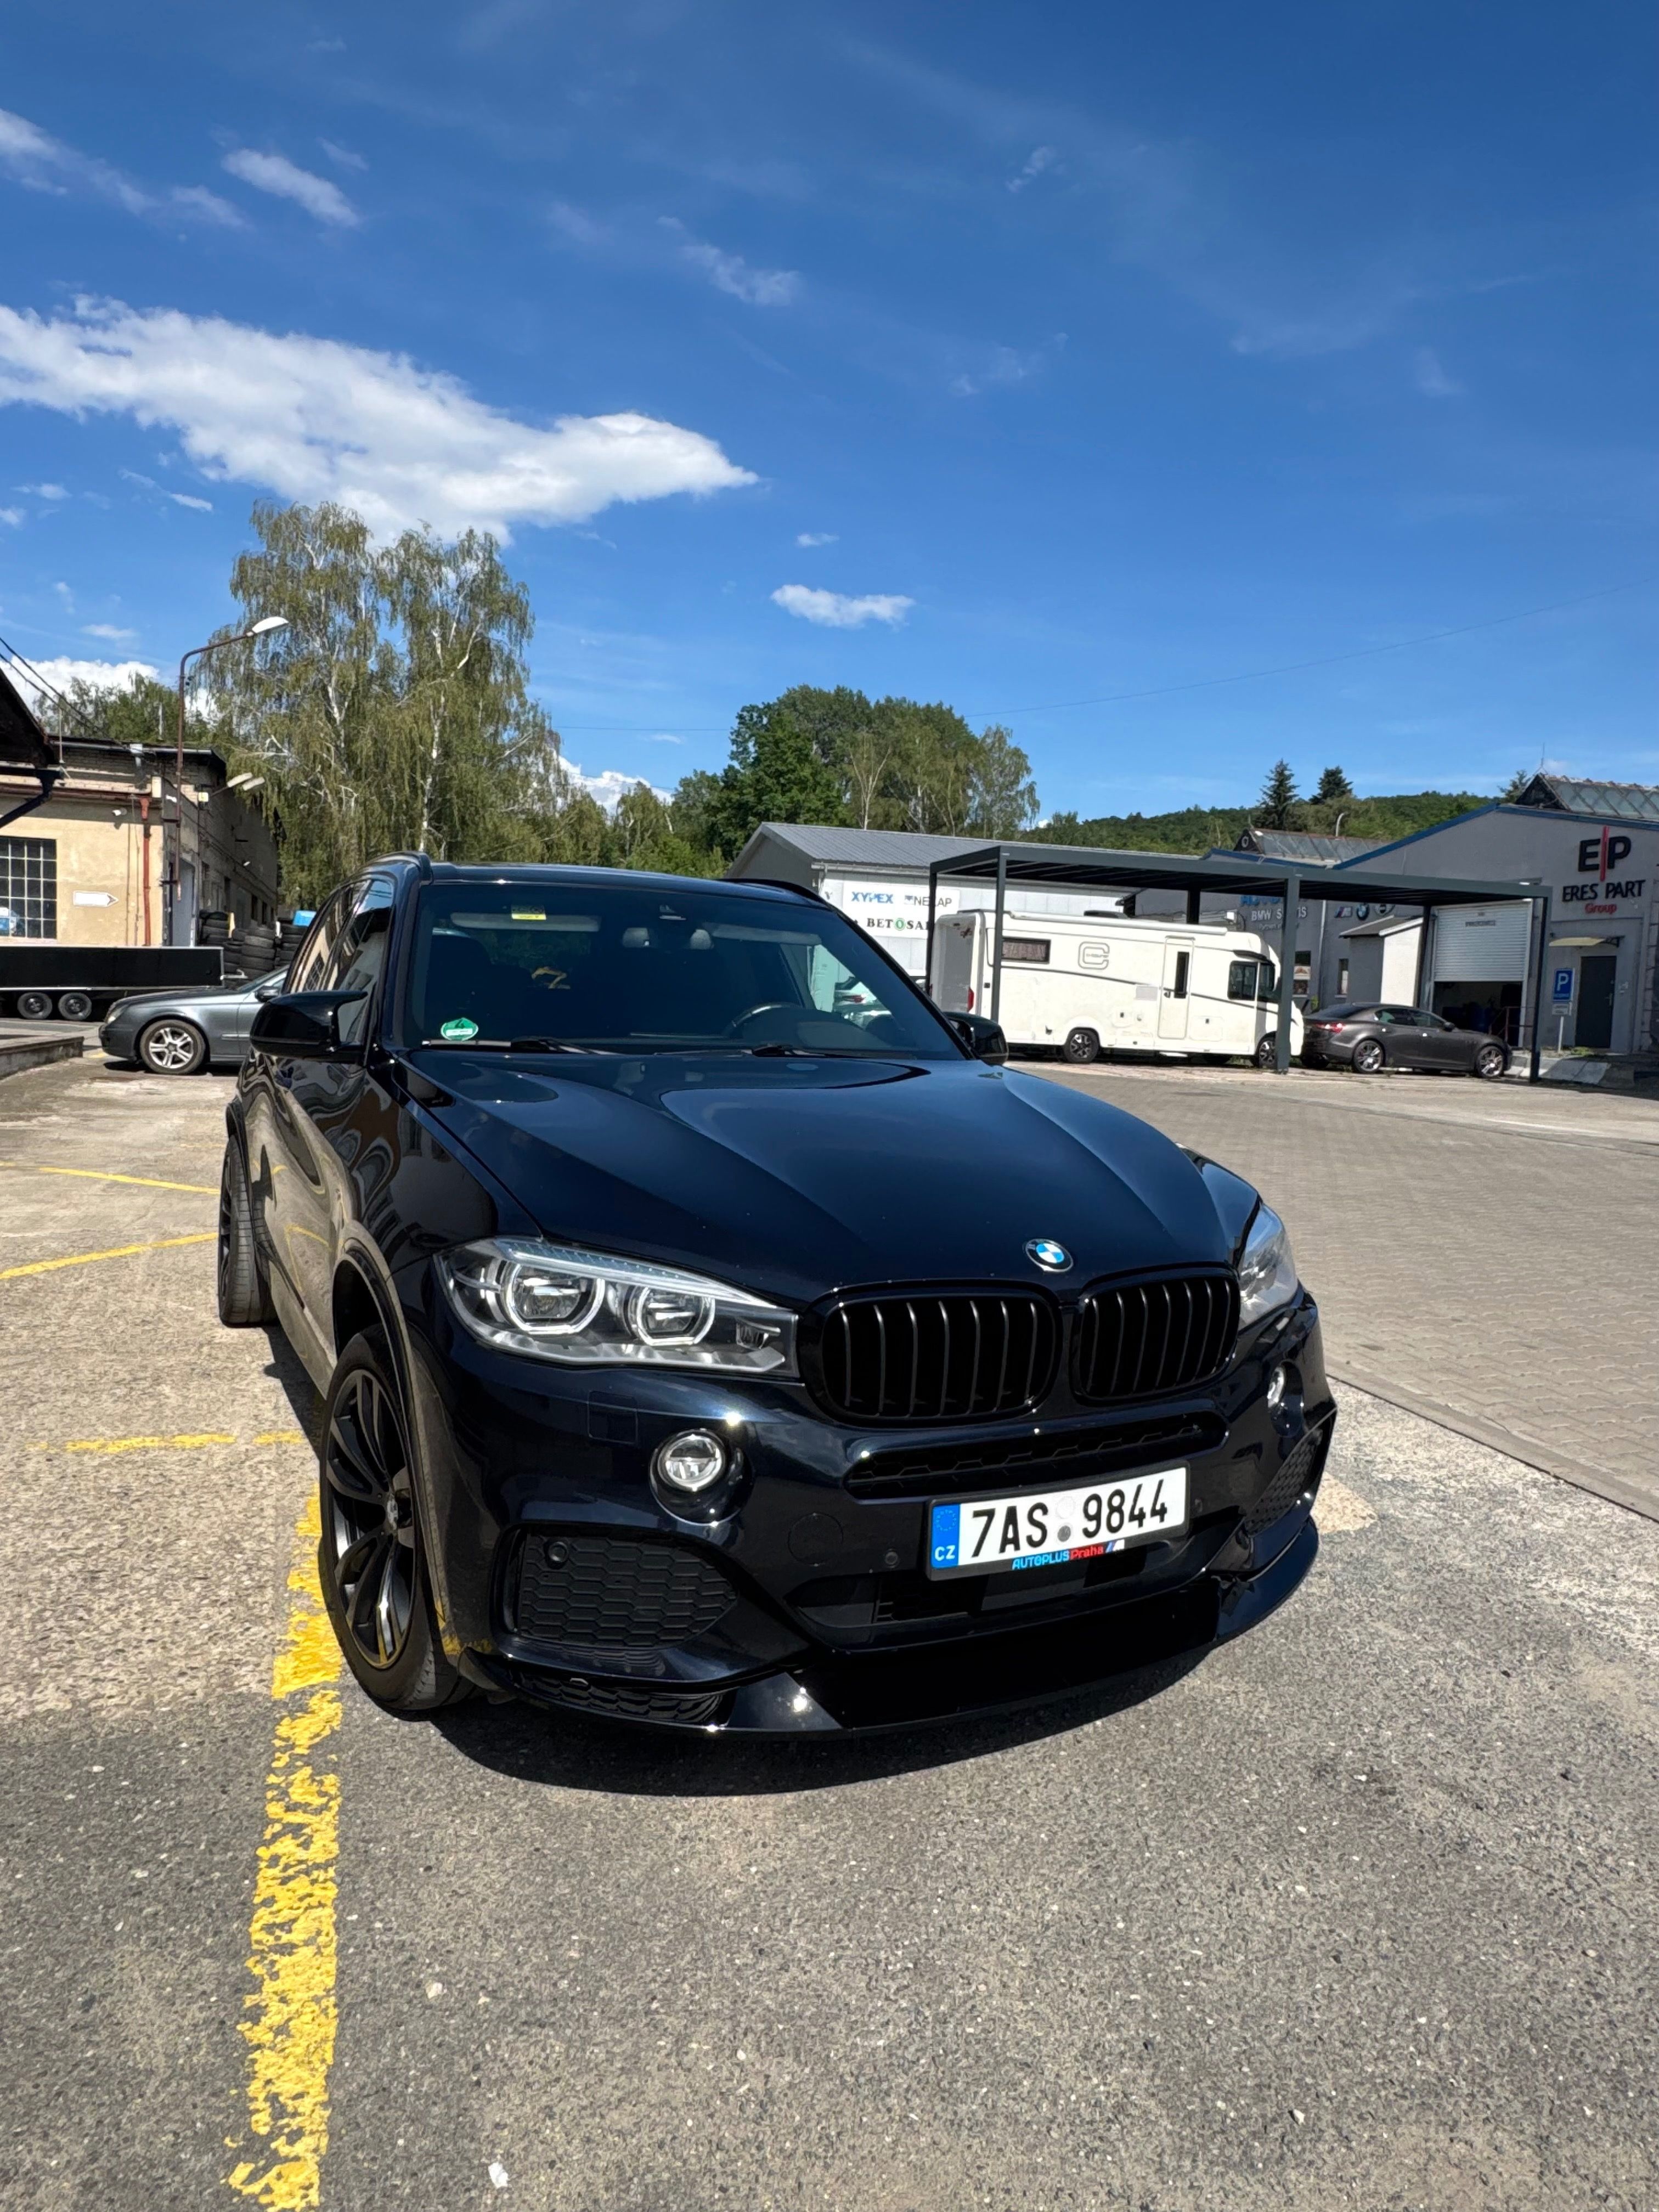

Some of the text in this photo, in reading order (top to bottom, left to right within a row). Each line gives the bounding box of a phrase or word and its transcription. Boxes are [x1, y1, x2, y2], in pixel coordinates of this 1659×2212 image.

[851, 891, 894, 904] XYPEX
[1562, 879, 1646, 902] ERES PART
[913, 895, 952, 907] NEAP
[1584, 903, 1617, 915] Group
[1251, 909, 1272, 922] BMW
[1557, 973, 1569, 991] P
[971, 1479, 1168, 1558] 7AS 9844
[934, 1544, 956, 1561] CZ
[1012, 1544, 1104, 1570] AUTOPLUS Praha
